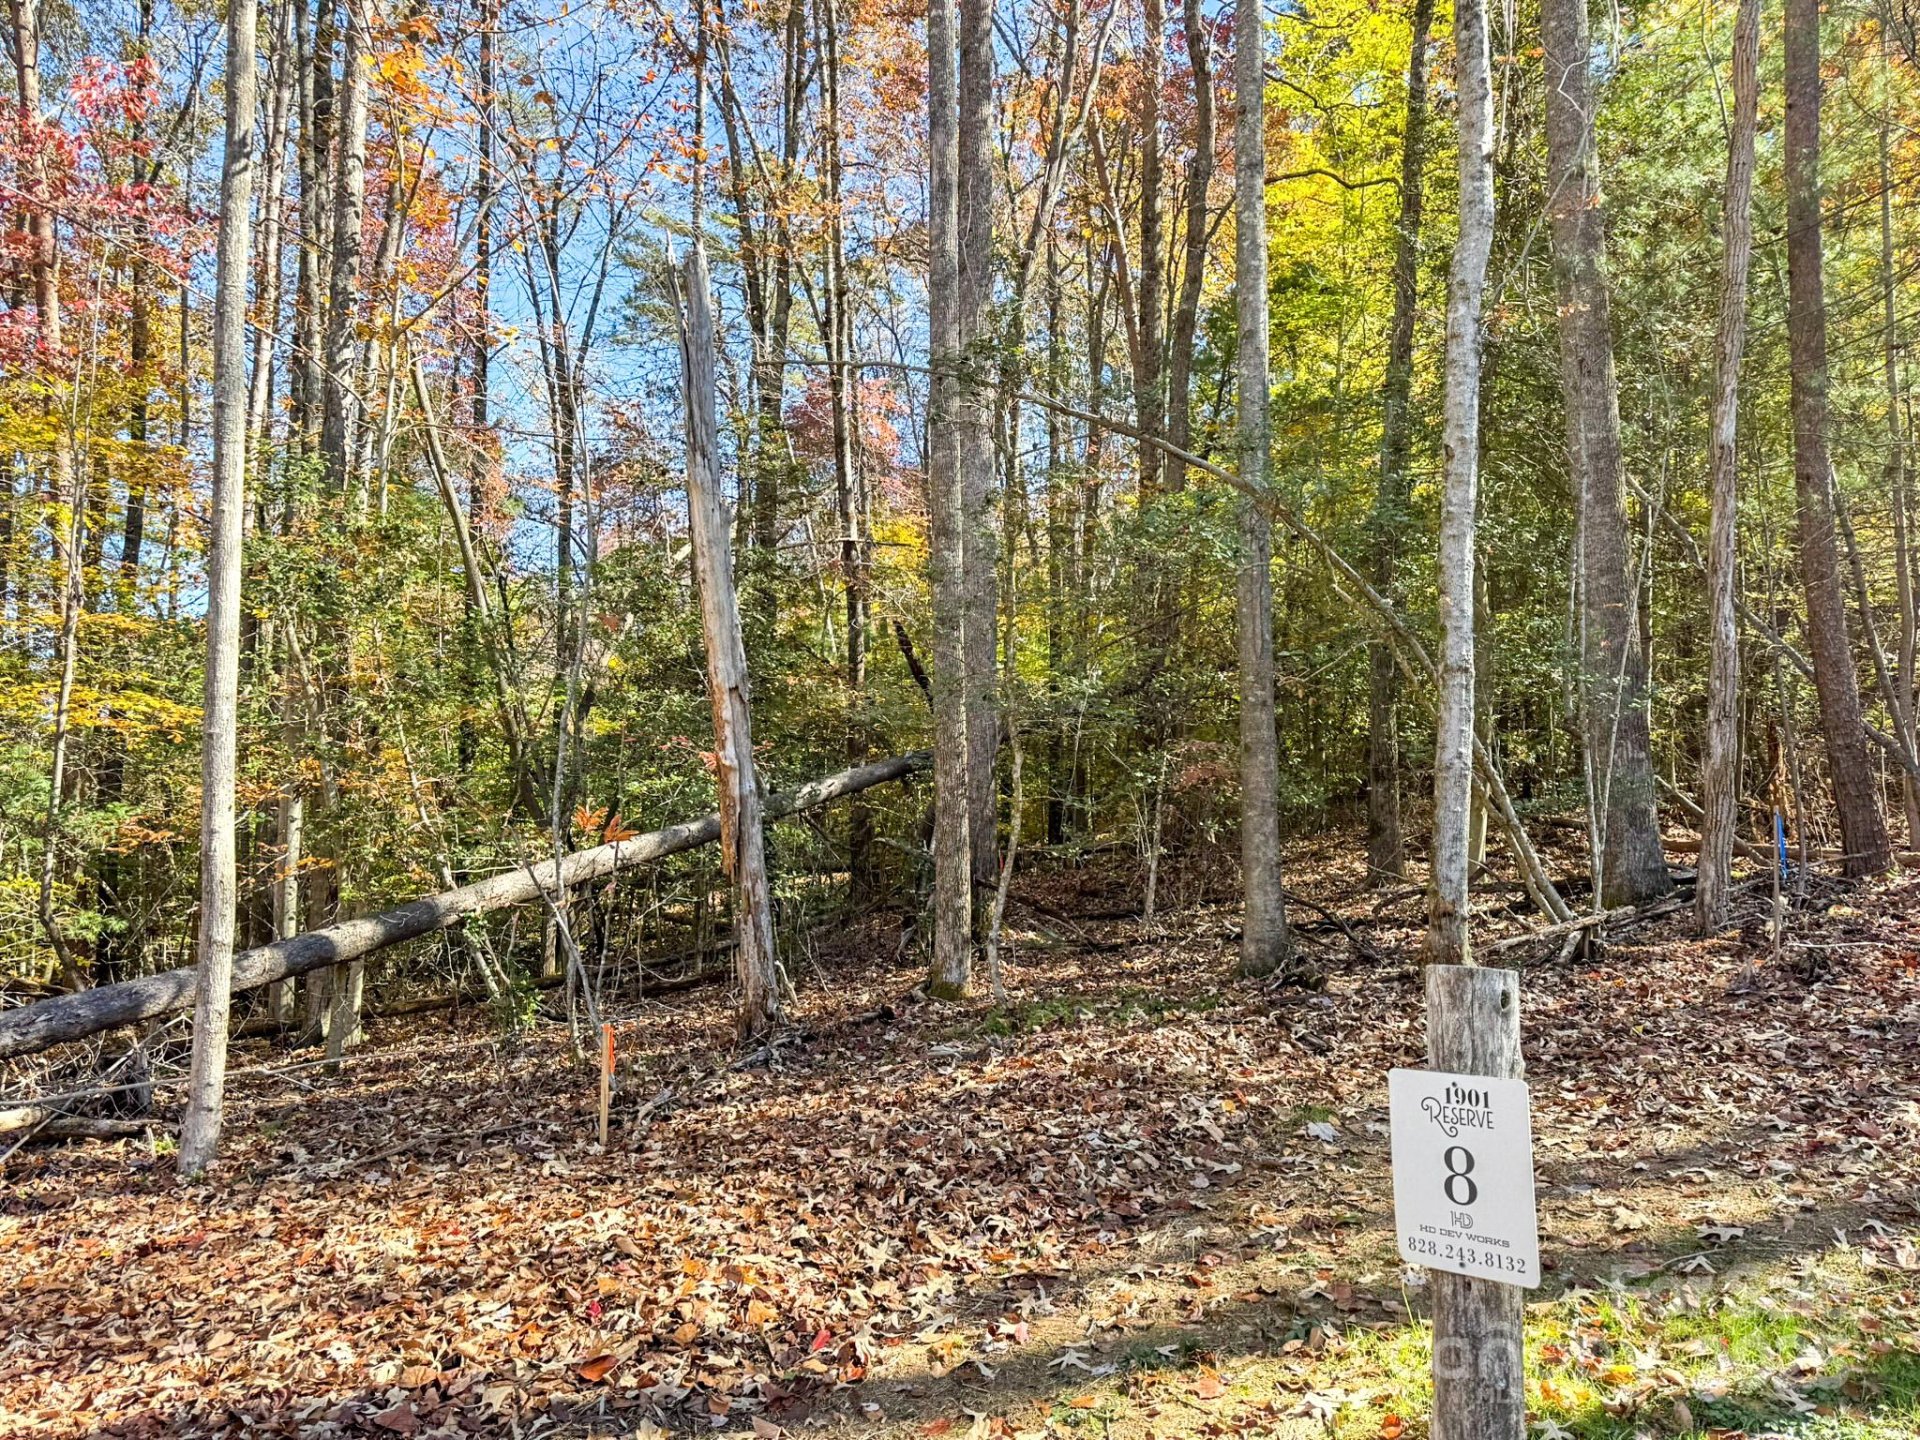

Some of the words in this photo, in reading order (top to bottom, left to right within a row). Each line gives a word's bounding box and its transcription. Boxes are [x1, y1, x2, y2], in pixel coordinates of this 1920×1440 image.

[1445, 1086, 1490, 1109] 1901
[1421, 1096, 1495, 1138] RESERVE
[1444, 1145, 1478, 1206] 8
[1408, 1236, 1527, 1274] 828.243.8132
[1419, 1224, 1437, 1235] HD
[1439, 1227, 1464, 1239] DEV
[1464, 1232, 1511, 1249] WORKS
